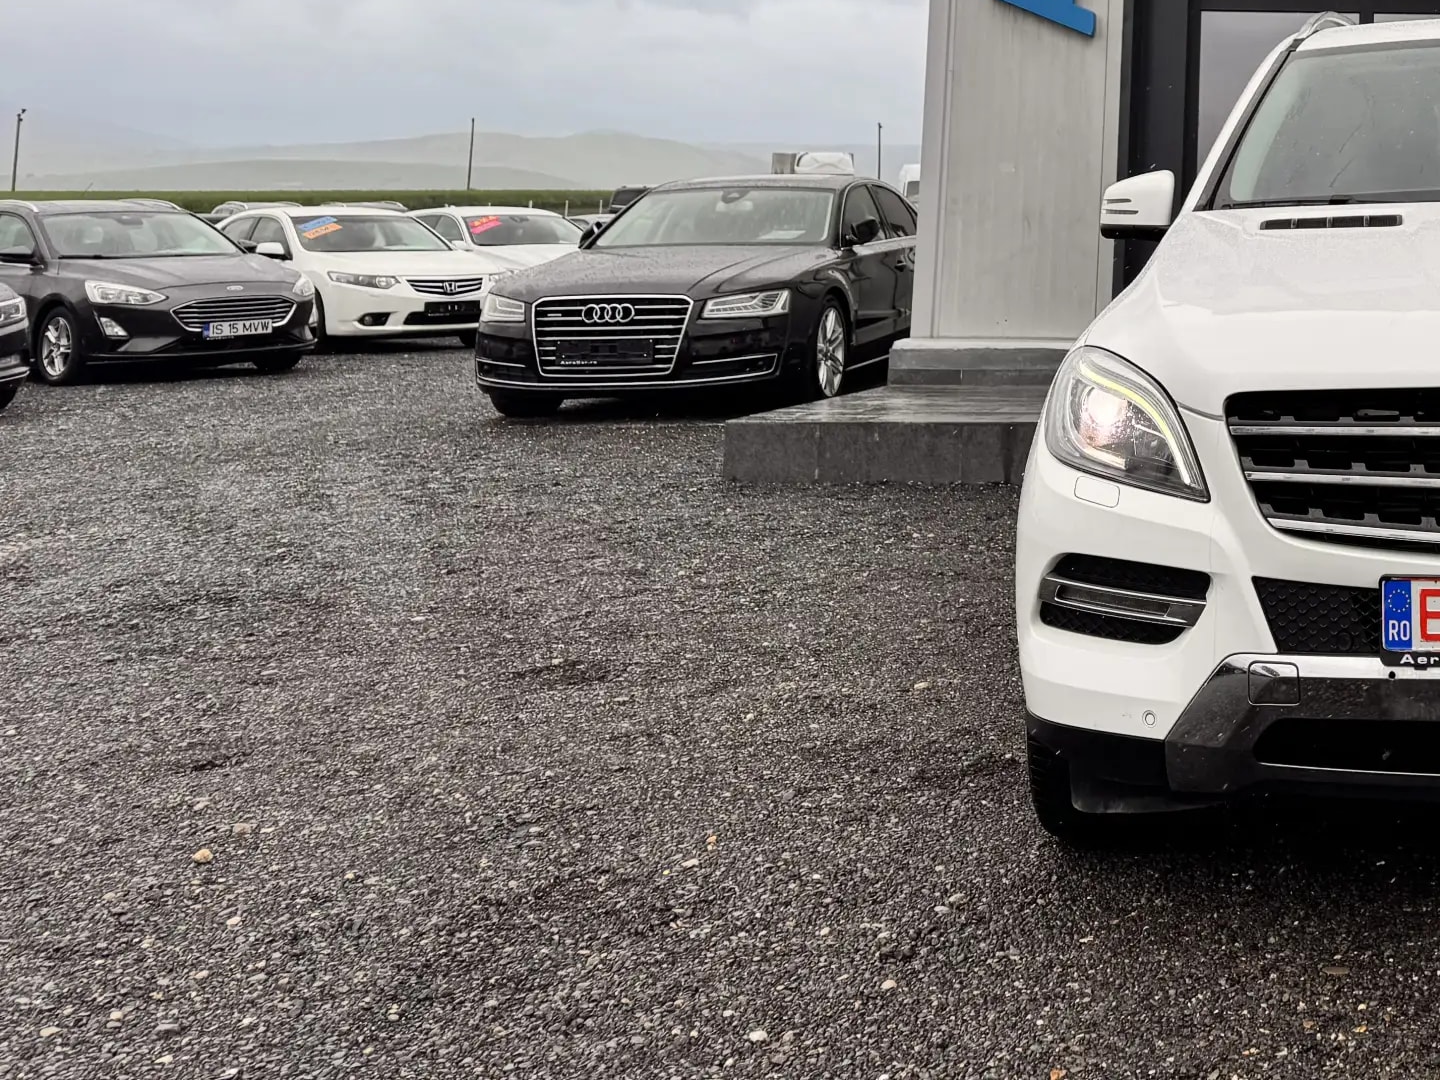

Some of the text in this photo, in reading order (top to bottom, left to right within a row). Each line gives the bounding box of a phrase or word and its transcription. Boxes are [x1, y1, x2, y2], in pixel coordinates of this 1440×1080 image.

[212, 323, 224, 335] IS
[229, 322, 239, 334] 15
[242, 320, 270, 333] MVW
[1388, 620, 1410, 641] RO
